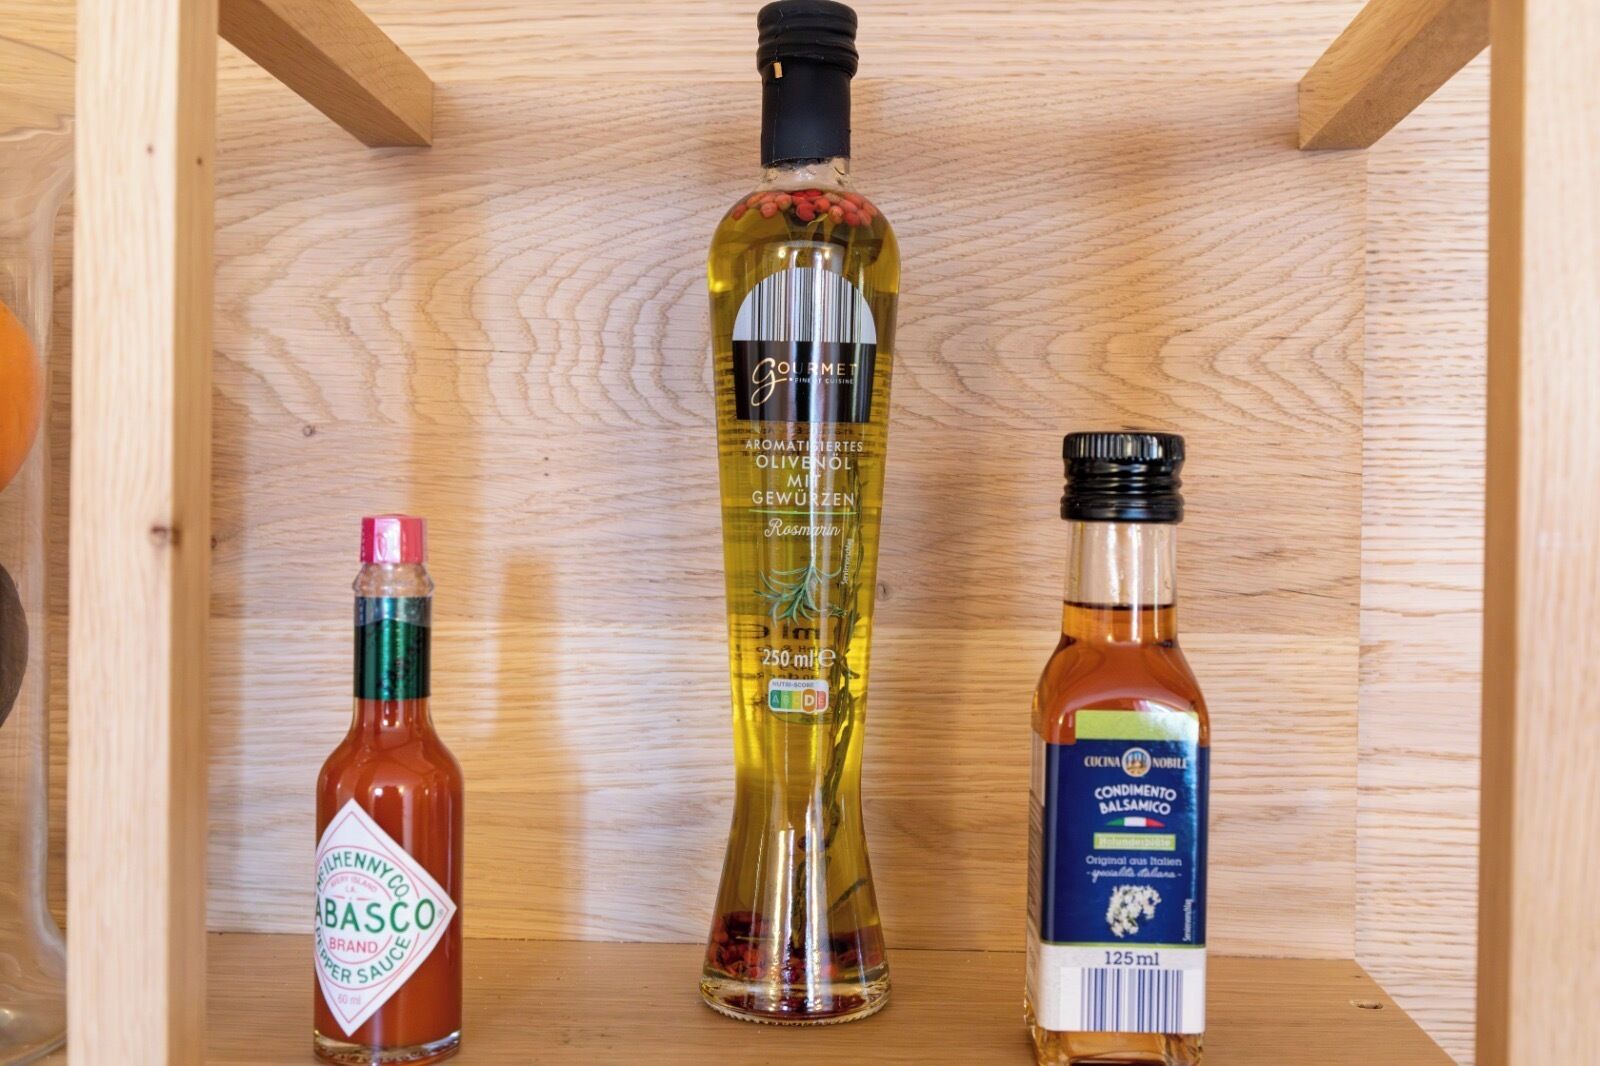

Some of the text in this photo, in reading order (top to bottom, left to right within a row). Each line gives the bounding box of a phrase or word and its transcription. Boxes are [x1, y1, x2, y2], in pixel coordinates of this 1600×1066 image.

[756, 453, 852, 470] OLIVENÖL
[752, 488, 855, 507] GEWÜRZEN
[764, 517, 841, 538] Rosmarin
[762, 649, 790, 667] 250
[794, 650, 814, 668] ml
[1084, 756, 1120, 767] CUCINA
[1094, 784, 1177, 801] CONDIMENTO
[1099, 799, 1171, 815] BALSAMICO
[1086, 855, 1183, 867] Original aus Italien
[315, 898, 436, 935] ABASCO
[329, 936, 379, 954] BRAND
[356, 935, 412, 984] SAUCE
[1105, 951, 1160, 966] 125 ml
